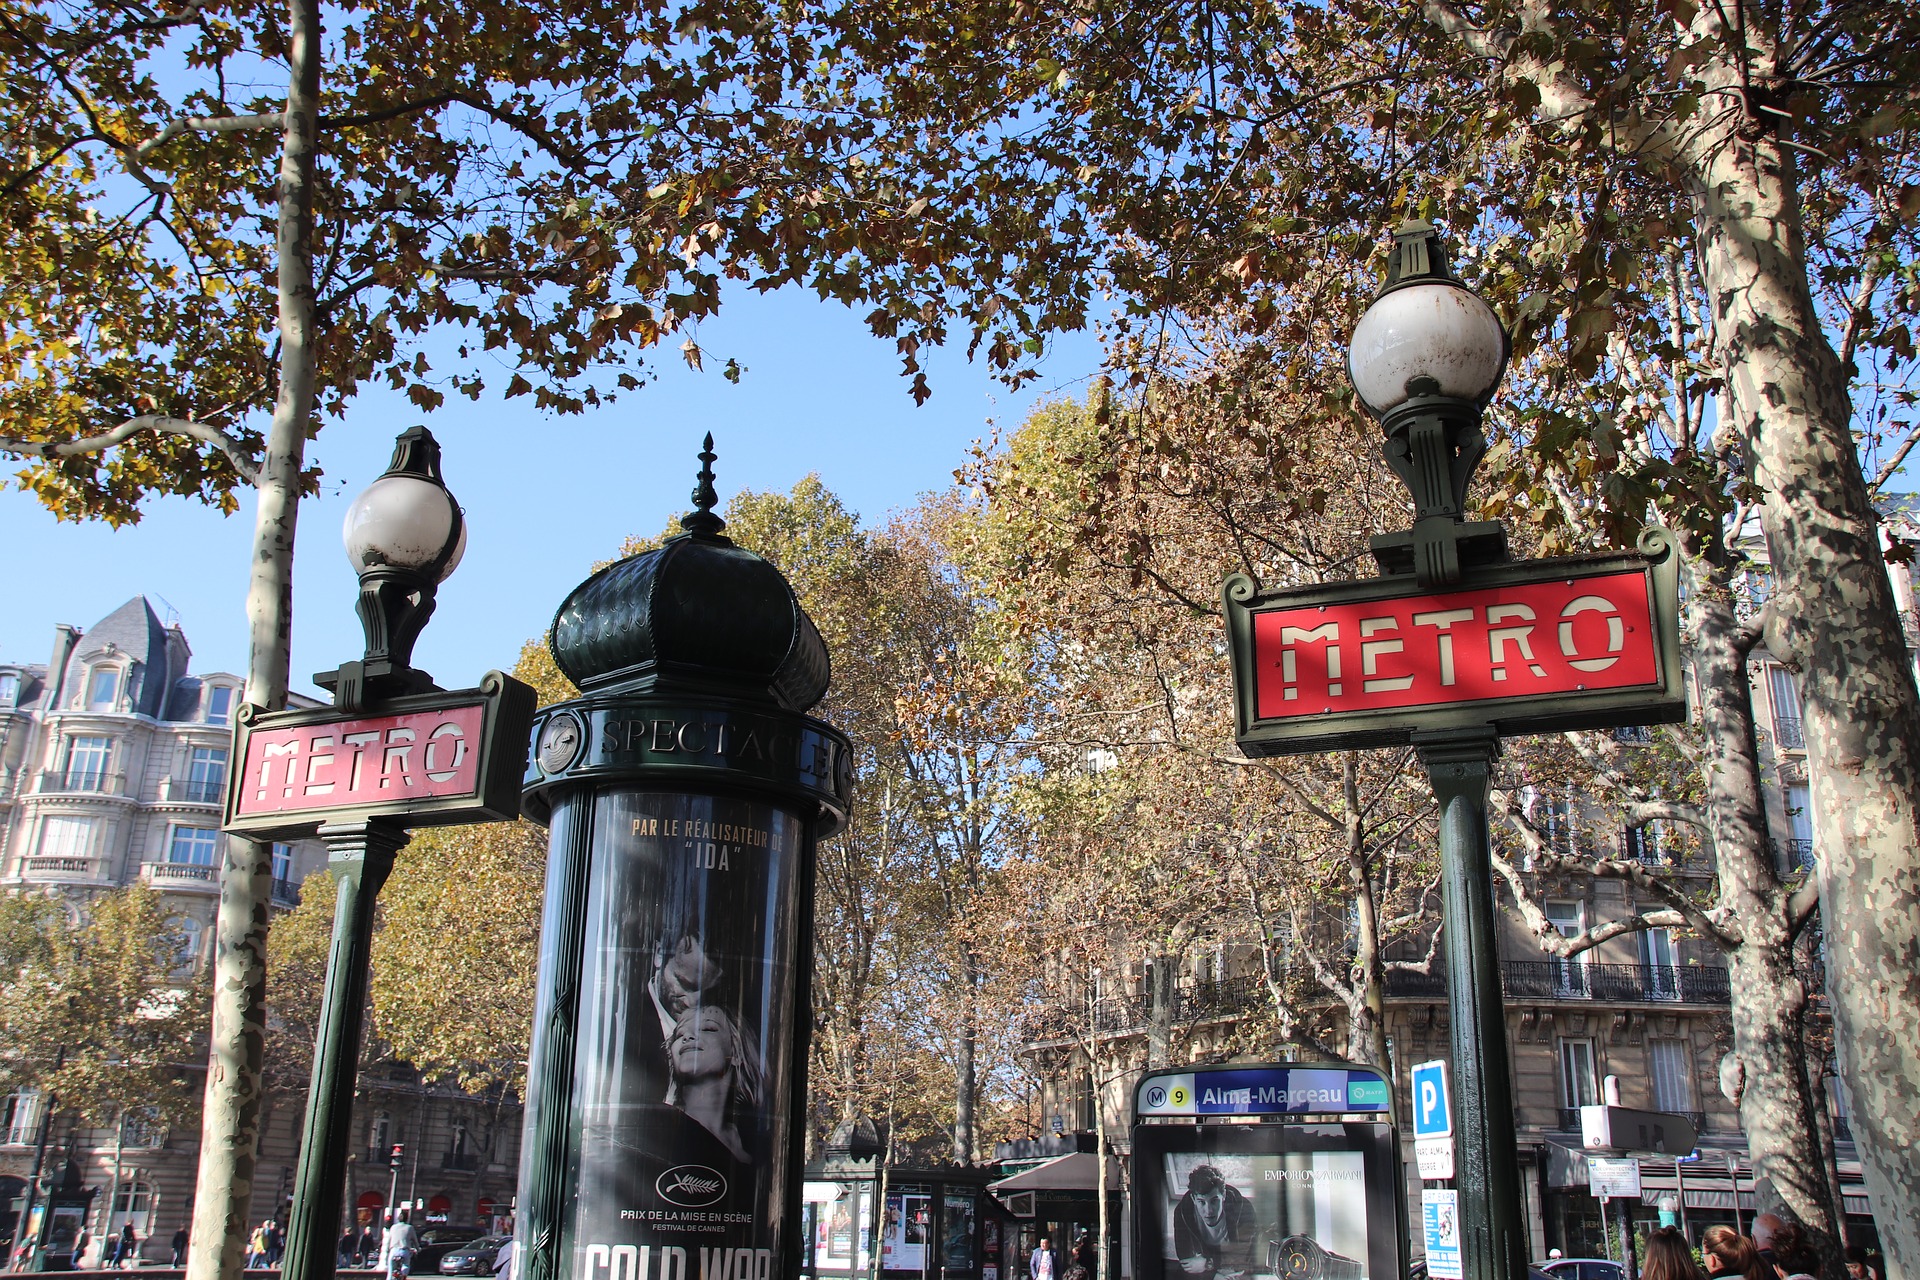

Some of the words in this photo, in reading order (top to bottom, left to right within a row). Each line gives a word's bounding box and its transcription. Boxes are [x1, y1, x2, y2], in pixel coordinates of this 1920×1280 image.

[1280, 594, 1624, 701] METRO
[256, 722, 464, 800] METRO
[632, 819, 658, 836] PAR
[664, 821, 678, 837] LE
[685, 818, 768, 847] RÉALISATEUR
[771, 835, 783, 852] DE
[1175, 1091, 1184, 1103] 9
[1202, 1087, 1342, 1105] Alma-Marceau
[1421, 1080, 1437, 1125] P
[1264, 1170, 1310, 1180] EMPORIO
[1322, 1170, 1362, 1181] ARMANI
[944, 1198, 970, 1209] Numéro
[620, 1210, 646, 1220] PRIX
[648, 1211, 662, 1220] DE
[664, 1211, 678, 1221] LA
[680, 1212, 706, 1222] MISE
[708, 1213, 722, 1222] EN
[724, 1212, 752, 1223] SCÈNE
[965, 1207, 975, 1216] art
[652, 1223, 686, 1232] FESTIVAL
[698, 1225, 725, 1233] CANNES
